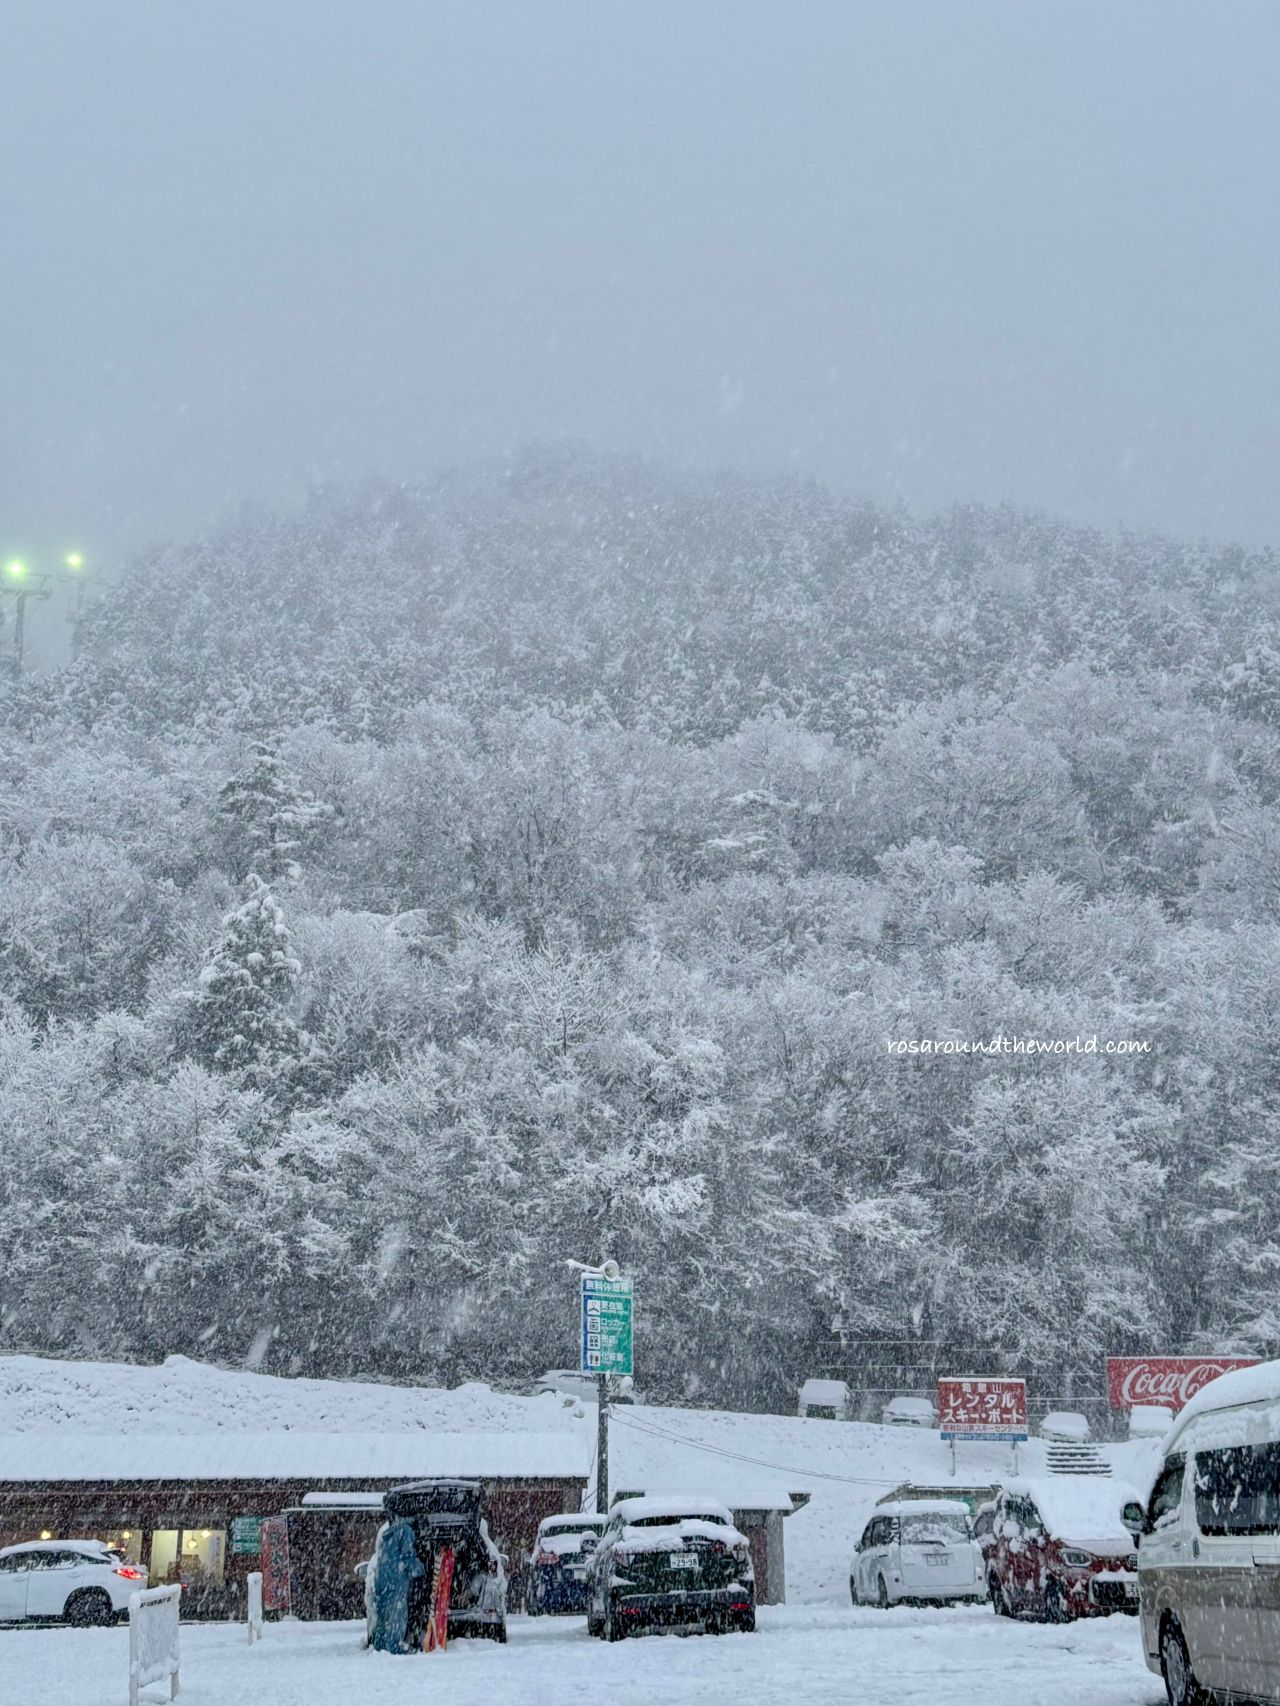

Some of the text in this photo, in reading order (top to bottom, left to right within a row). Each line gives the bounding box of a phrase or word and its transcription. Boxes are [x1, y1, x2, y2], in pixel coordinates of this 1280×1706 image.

[601, 1318, 625, 1327] ロッカー
[949, 1392, 1015, 1408] レンタル
